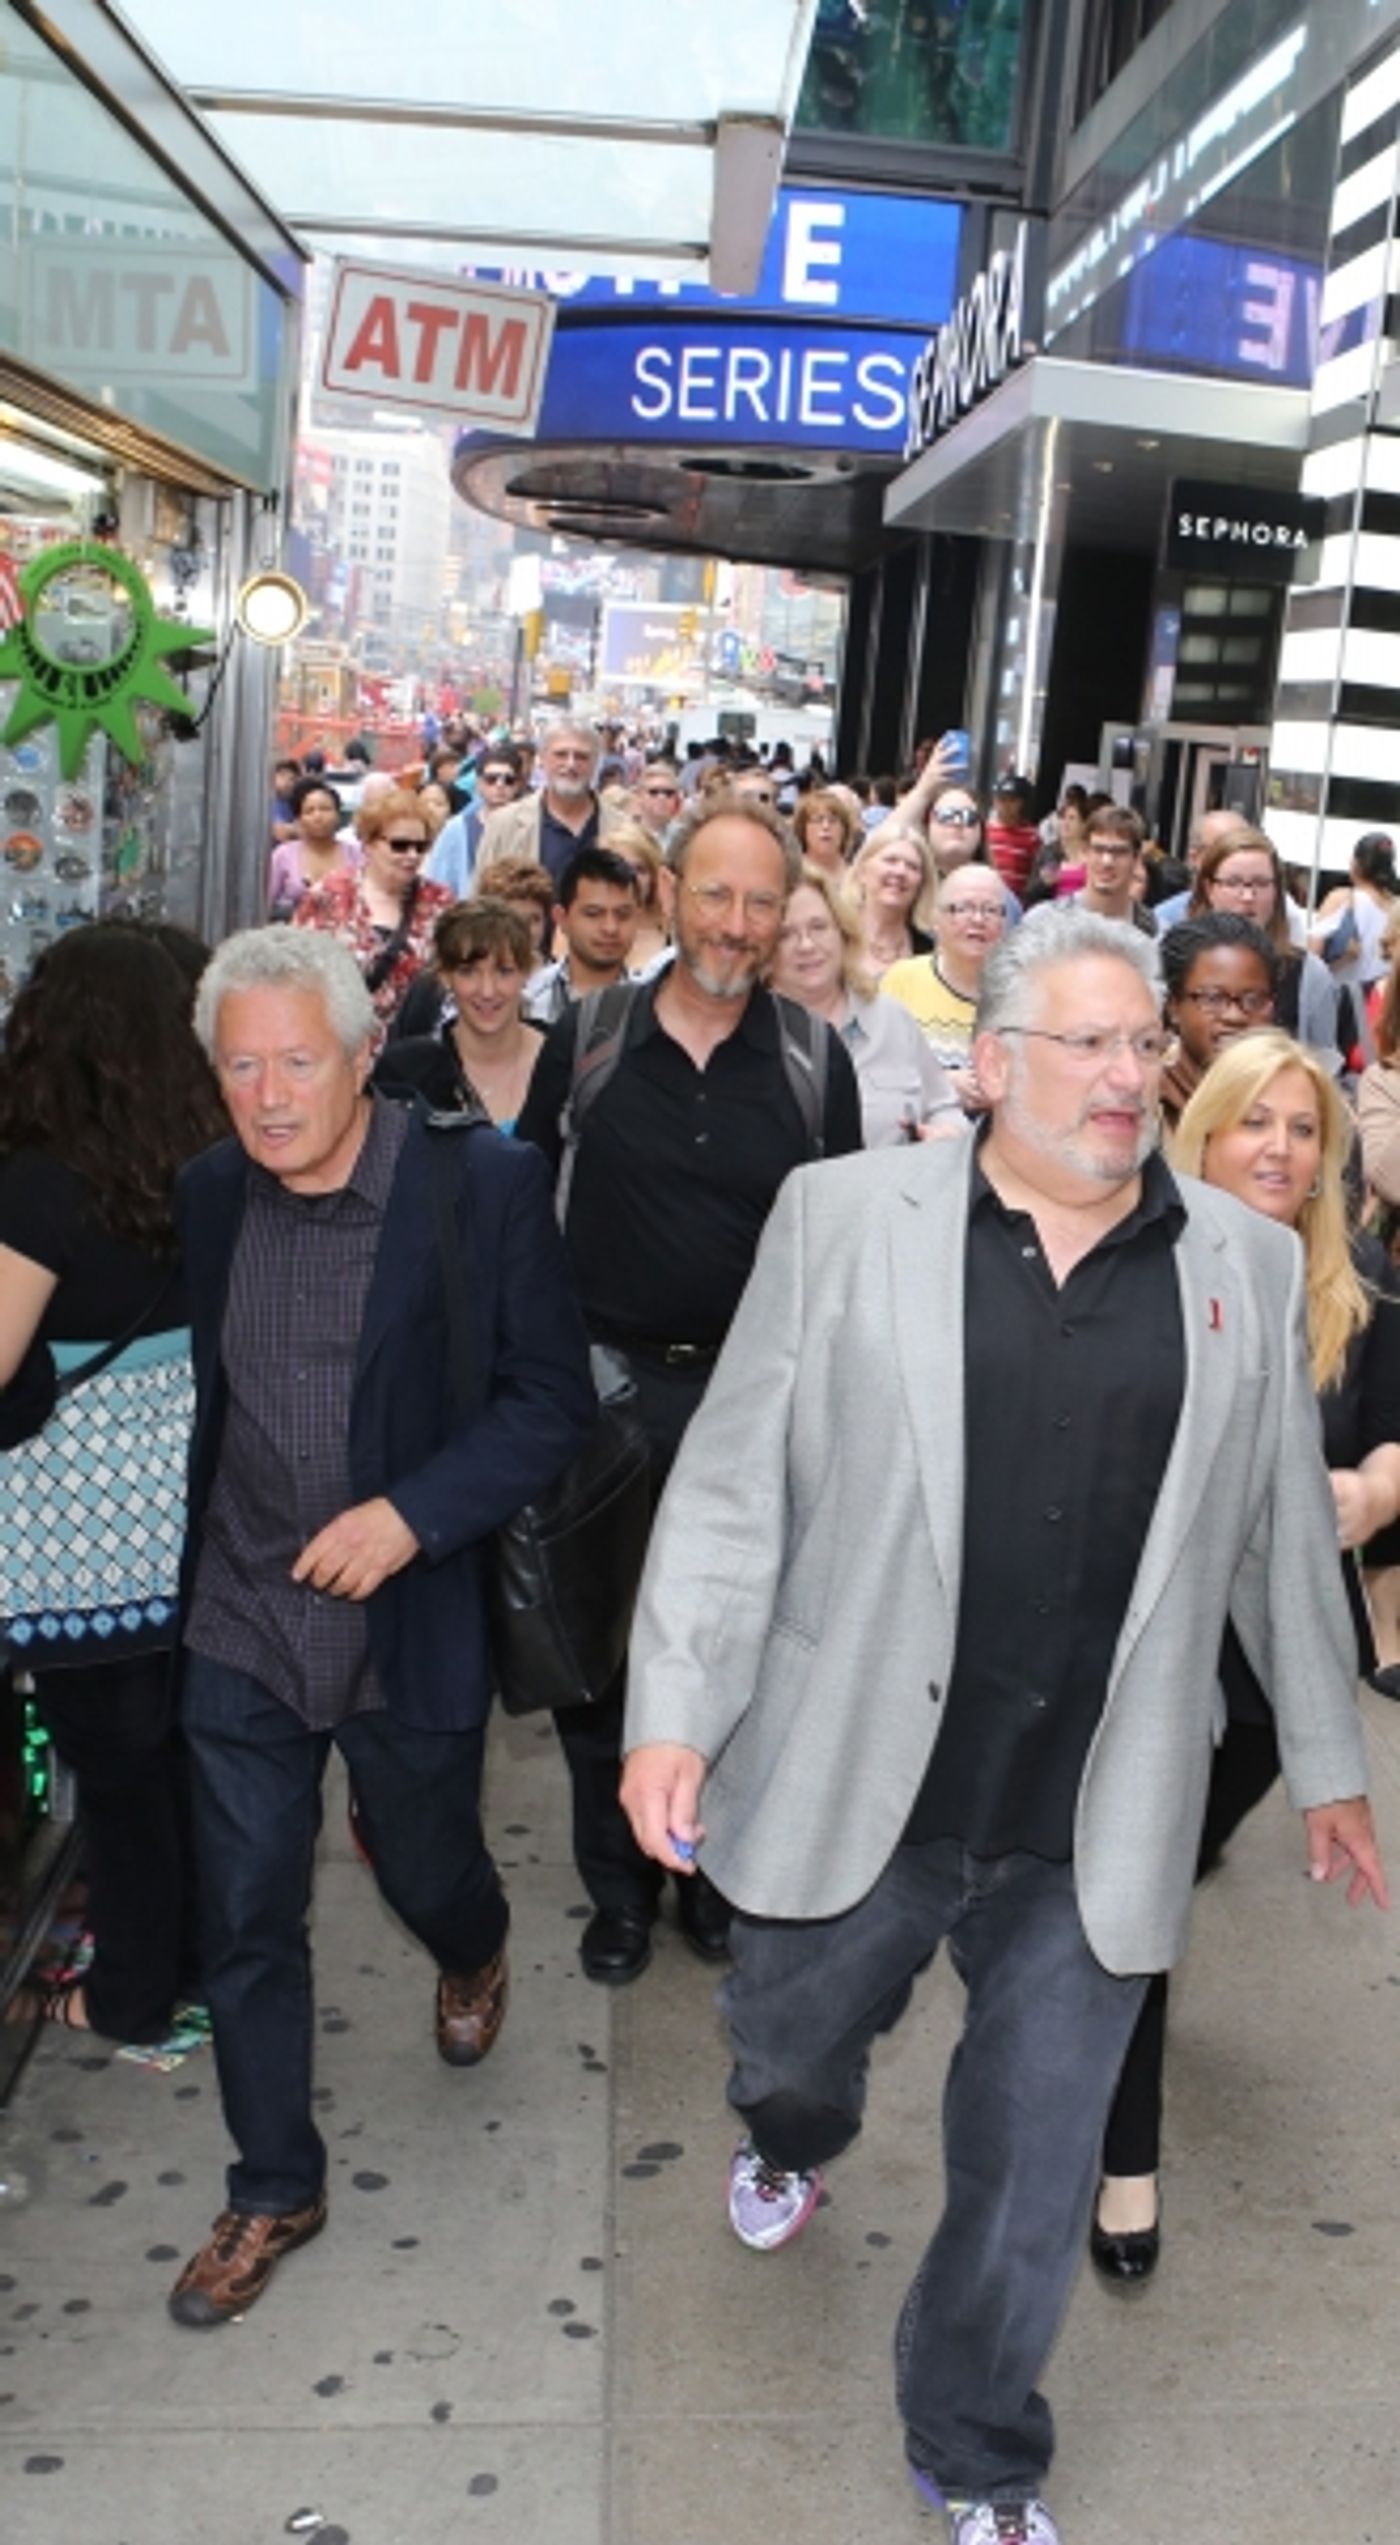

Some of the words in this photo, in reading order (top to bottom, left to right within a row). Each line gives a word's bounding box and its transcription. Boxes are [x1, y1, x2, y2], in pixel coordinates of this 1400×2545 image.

[343, 294, 527, 400] ATM
[631, 346, 906, 431] SERIES
[1178, 513, 1308, 548] SEPHORA
